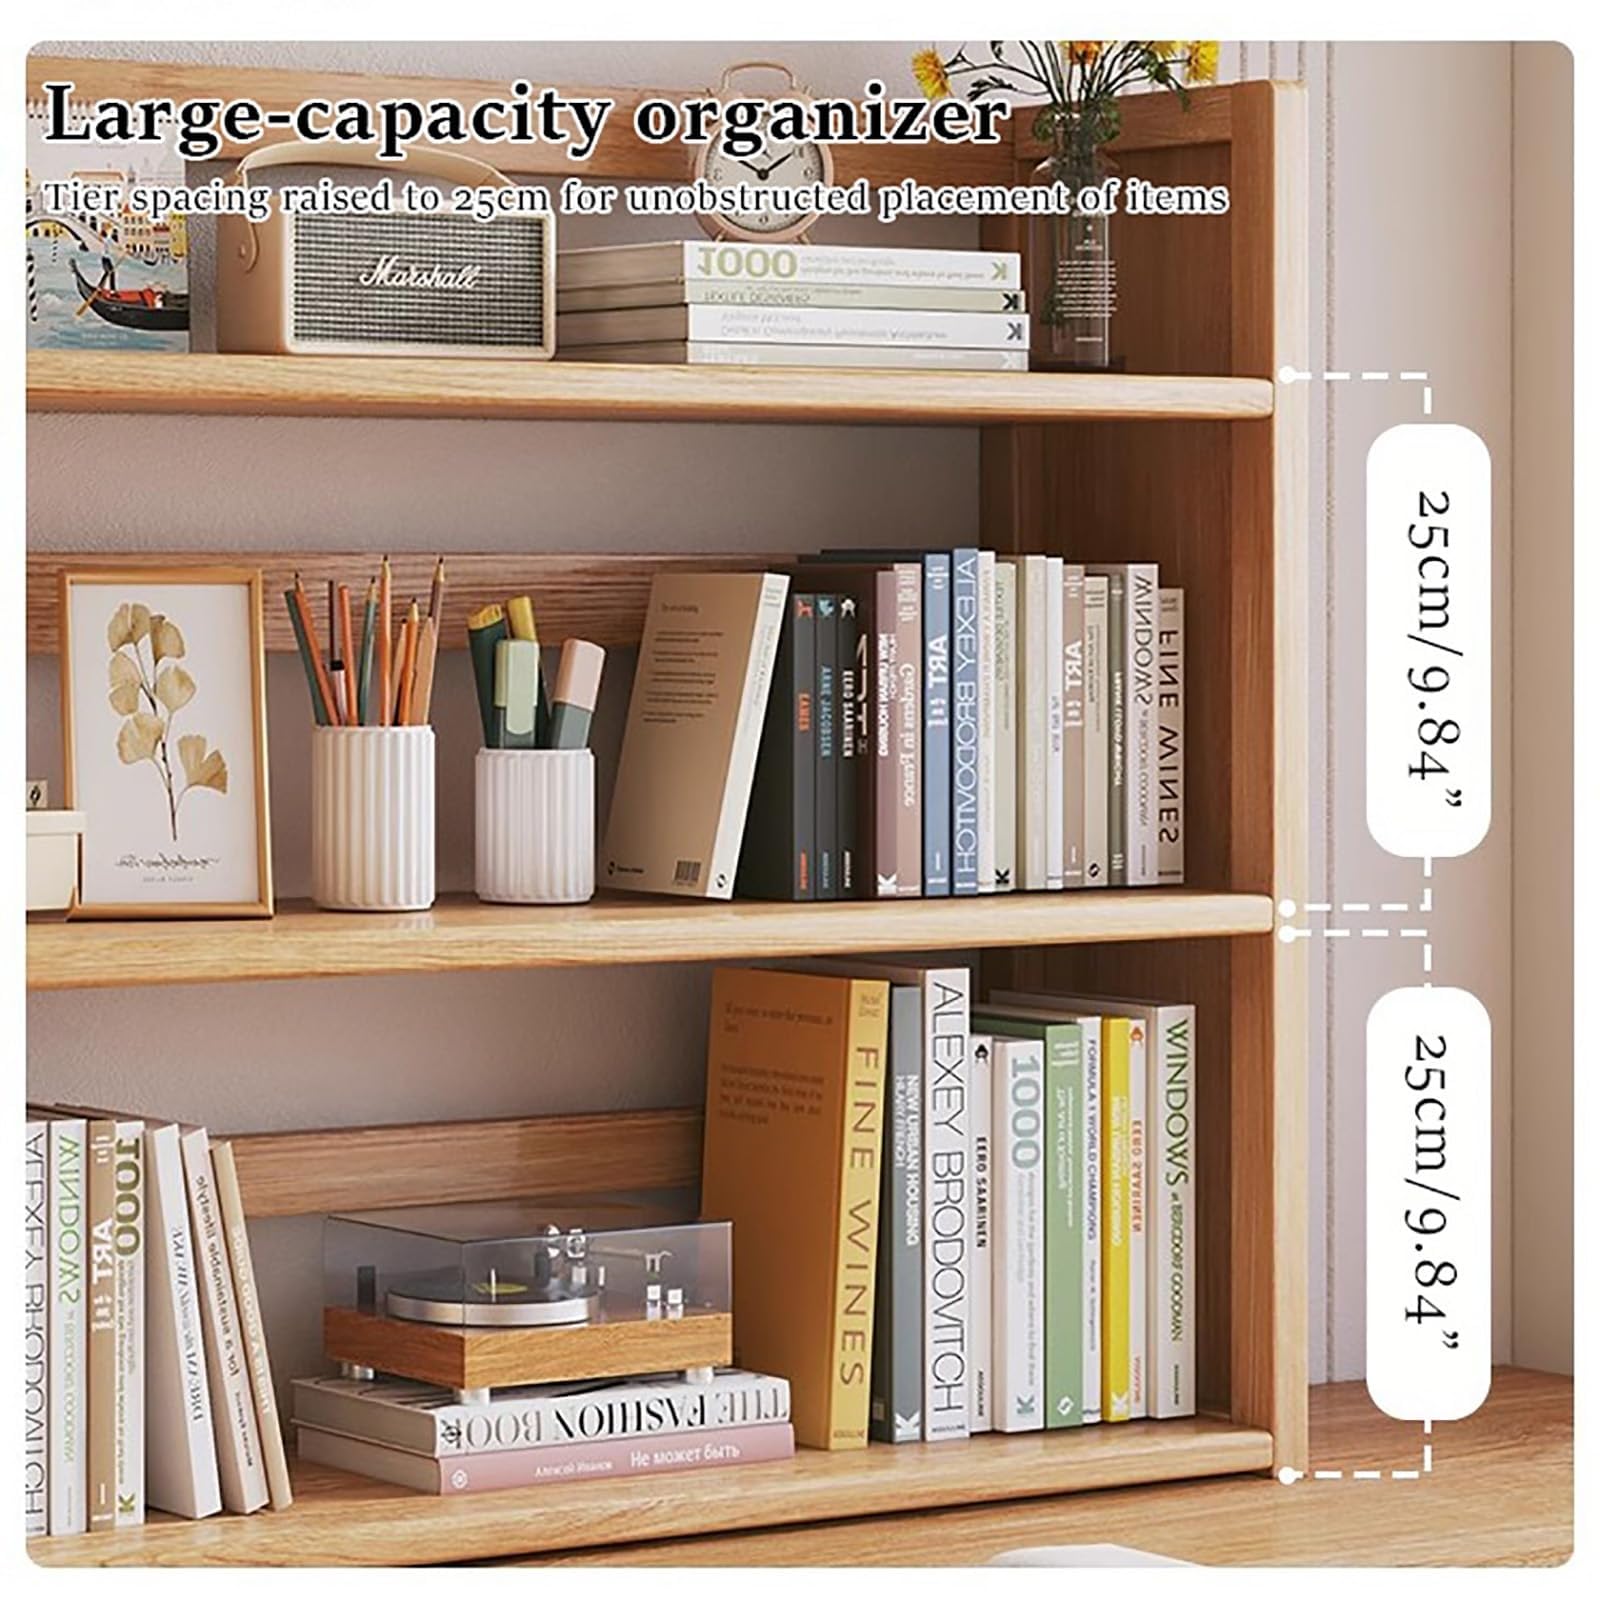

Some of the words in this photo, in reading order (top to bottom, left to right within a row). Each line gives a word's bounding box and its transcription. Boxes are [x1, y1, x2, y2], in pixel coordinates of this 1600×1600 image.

[359, 254, 481, 289] Marshall
[906, 1073, 920, 1107] NEW
[932, 981, 966, 1137] ALEXEY
[848, 1045, 880, 1170] FINE
[906, 1111, 920, 1168] URBAN
[1012, 1054, 1041, 1170] 1000
[1166, 1019, 1189, 1186] WINDOWS
[975, 1136, 987, 1174] EERO
[906, 1172, 920, 1247] HOUSING
[975, 1178, 987, 1249] SAARINEN
[838, 1199, 873, 1387] WINES
[932, 1150, 966, 1413] BRODOVITCH
[629, 1451, 651, 1468] Не
[653, 1448, 702, 1466] может
[703, 1442, 741, 1461] быть
